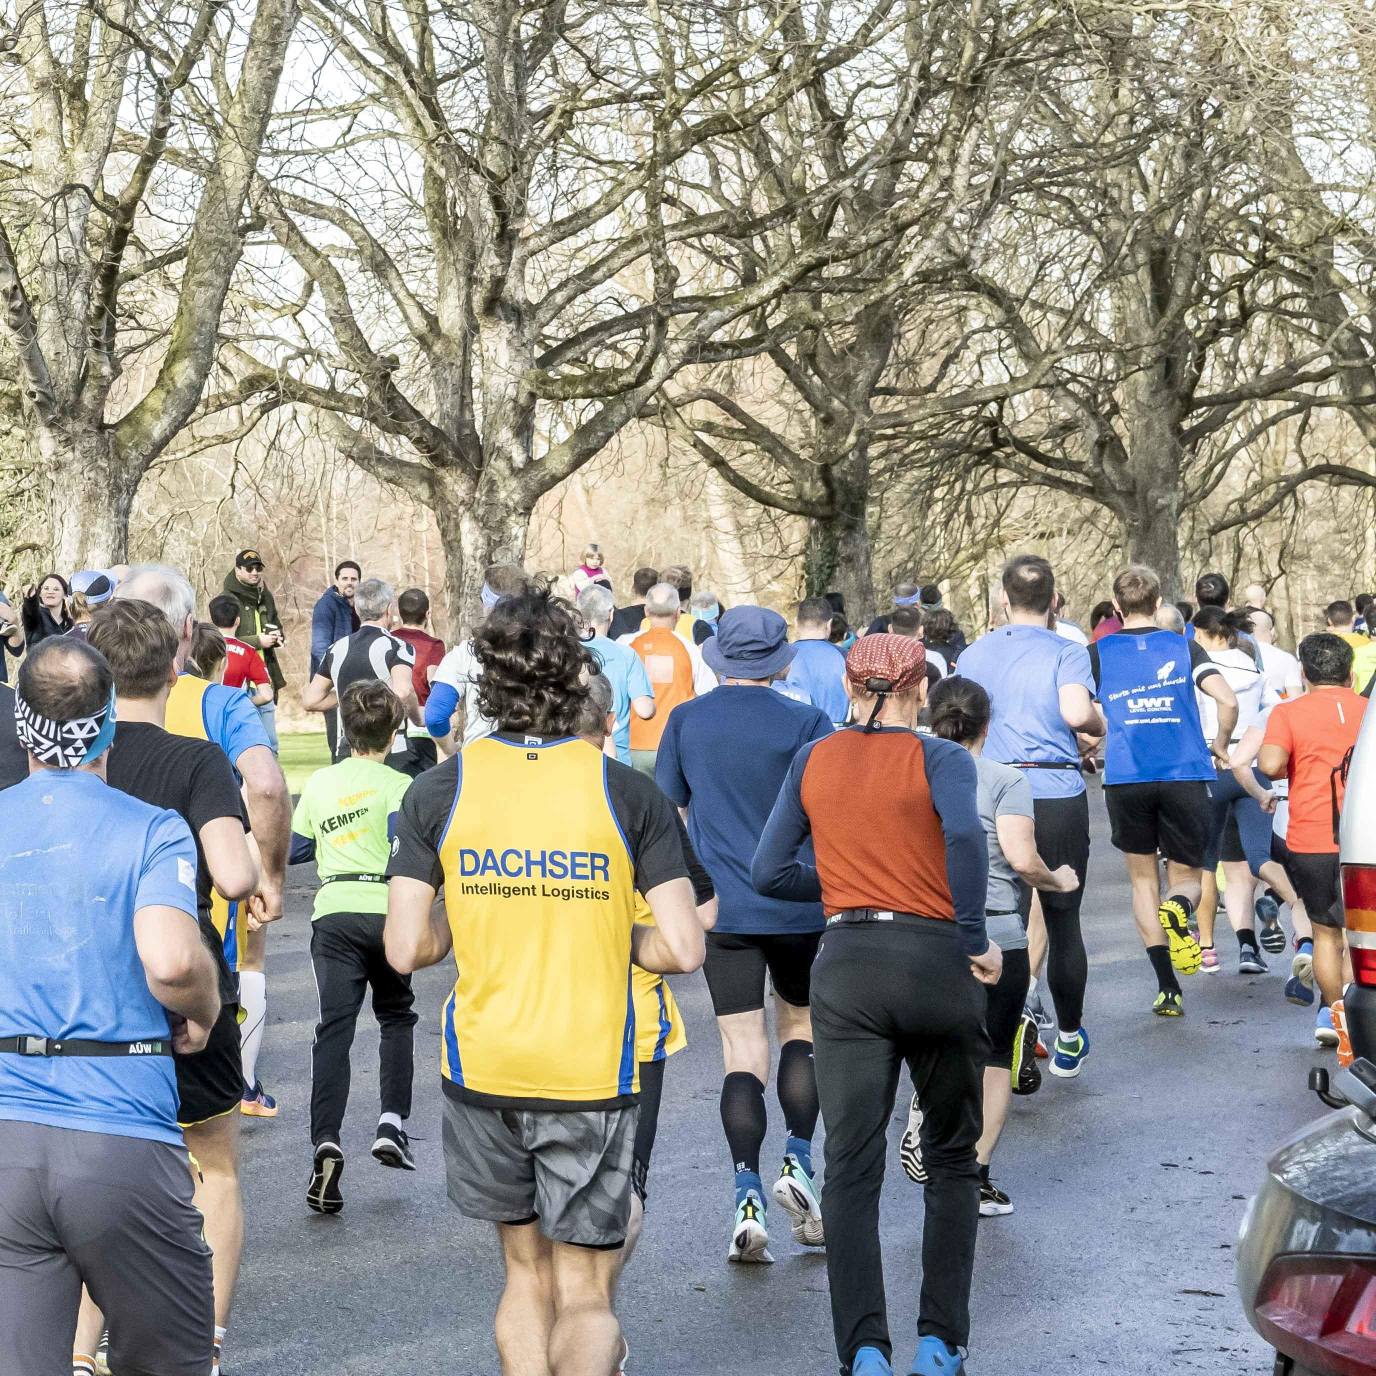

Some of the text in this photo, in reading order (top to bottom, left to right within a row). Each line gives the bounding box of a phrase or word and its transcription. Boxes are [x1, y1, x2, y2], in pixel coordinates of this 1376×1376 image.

[1127, 696, 1175, 708] UWT
[319, 807, 369, 837] KEMPTEN
[459, 848, 610, 881] DACHSER
[461, 883, 610, 901] Intelligent Logistics
[129, 1042, 152, 1054] AÜW
